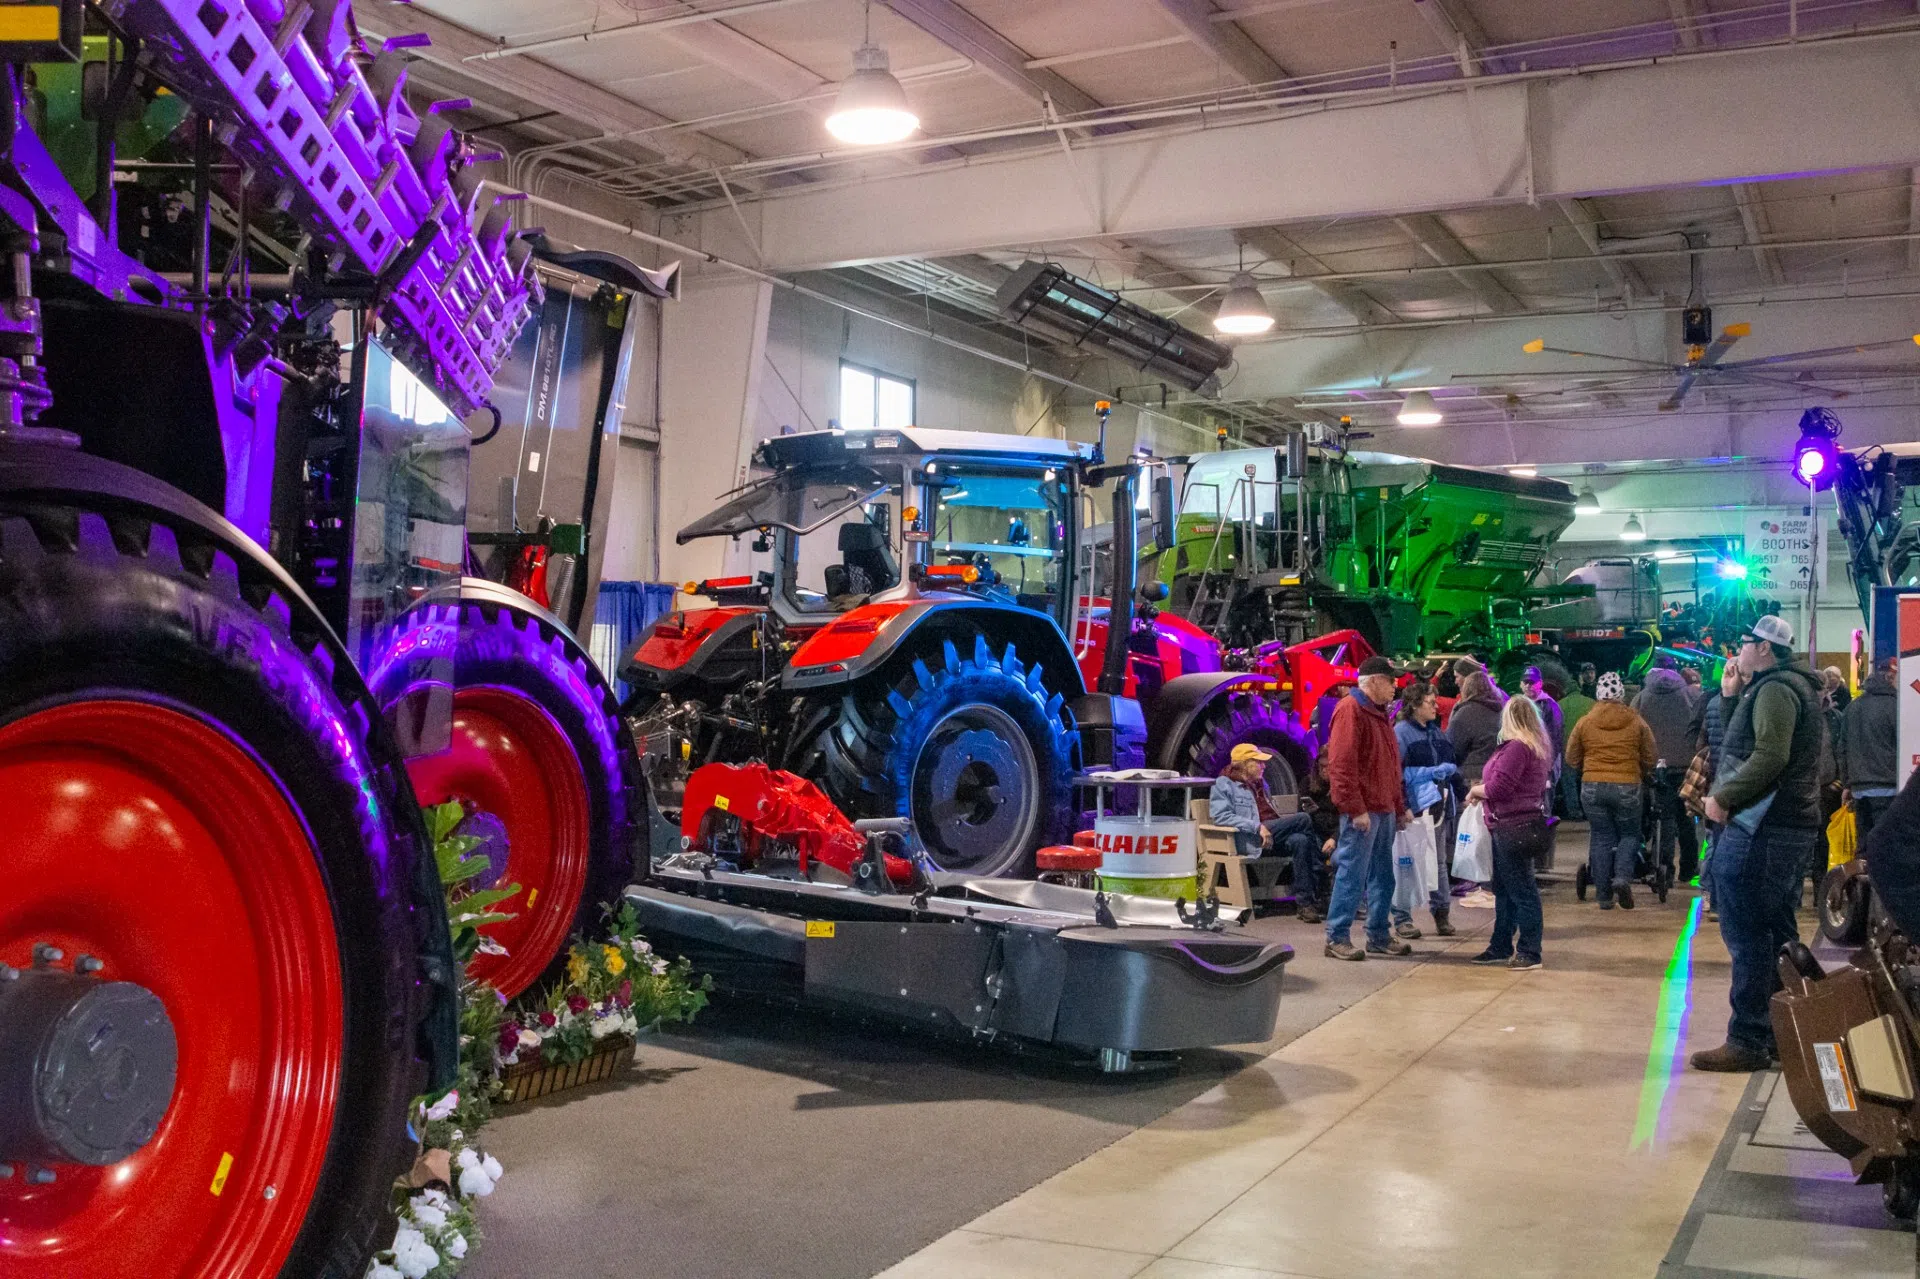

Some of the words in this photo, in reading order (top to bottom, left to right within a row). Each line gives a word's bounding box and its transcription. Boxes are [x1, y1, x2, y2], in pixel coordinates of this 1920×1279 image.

[1762, 539, 1809, 550] BOOTHS
[1575, 629, 1612, 637] FENDT
[1095, 833, 1179, 855] CLAAS
